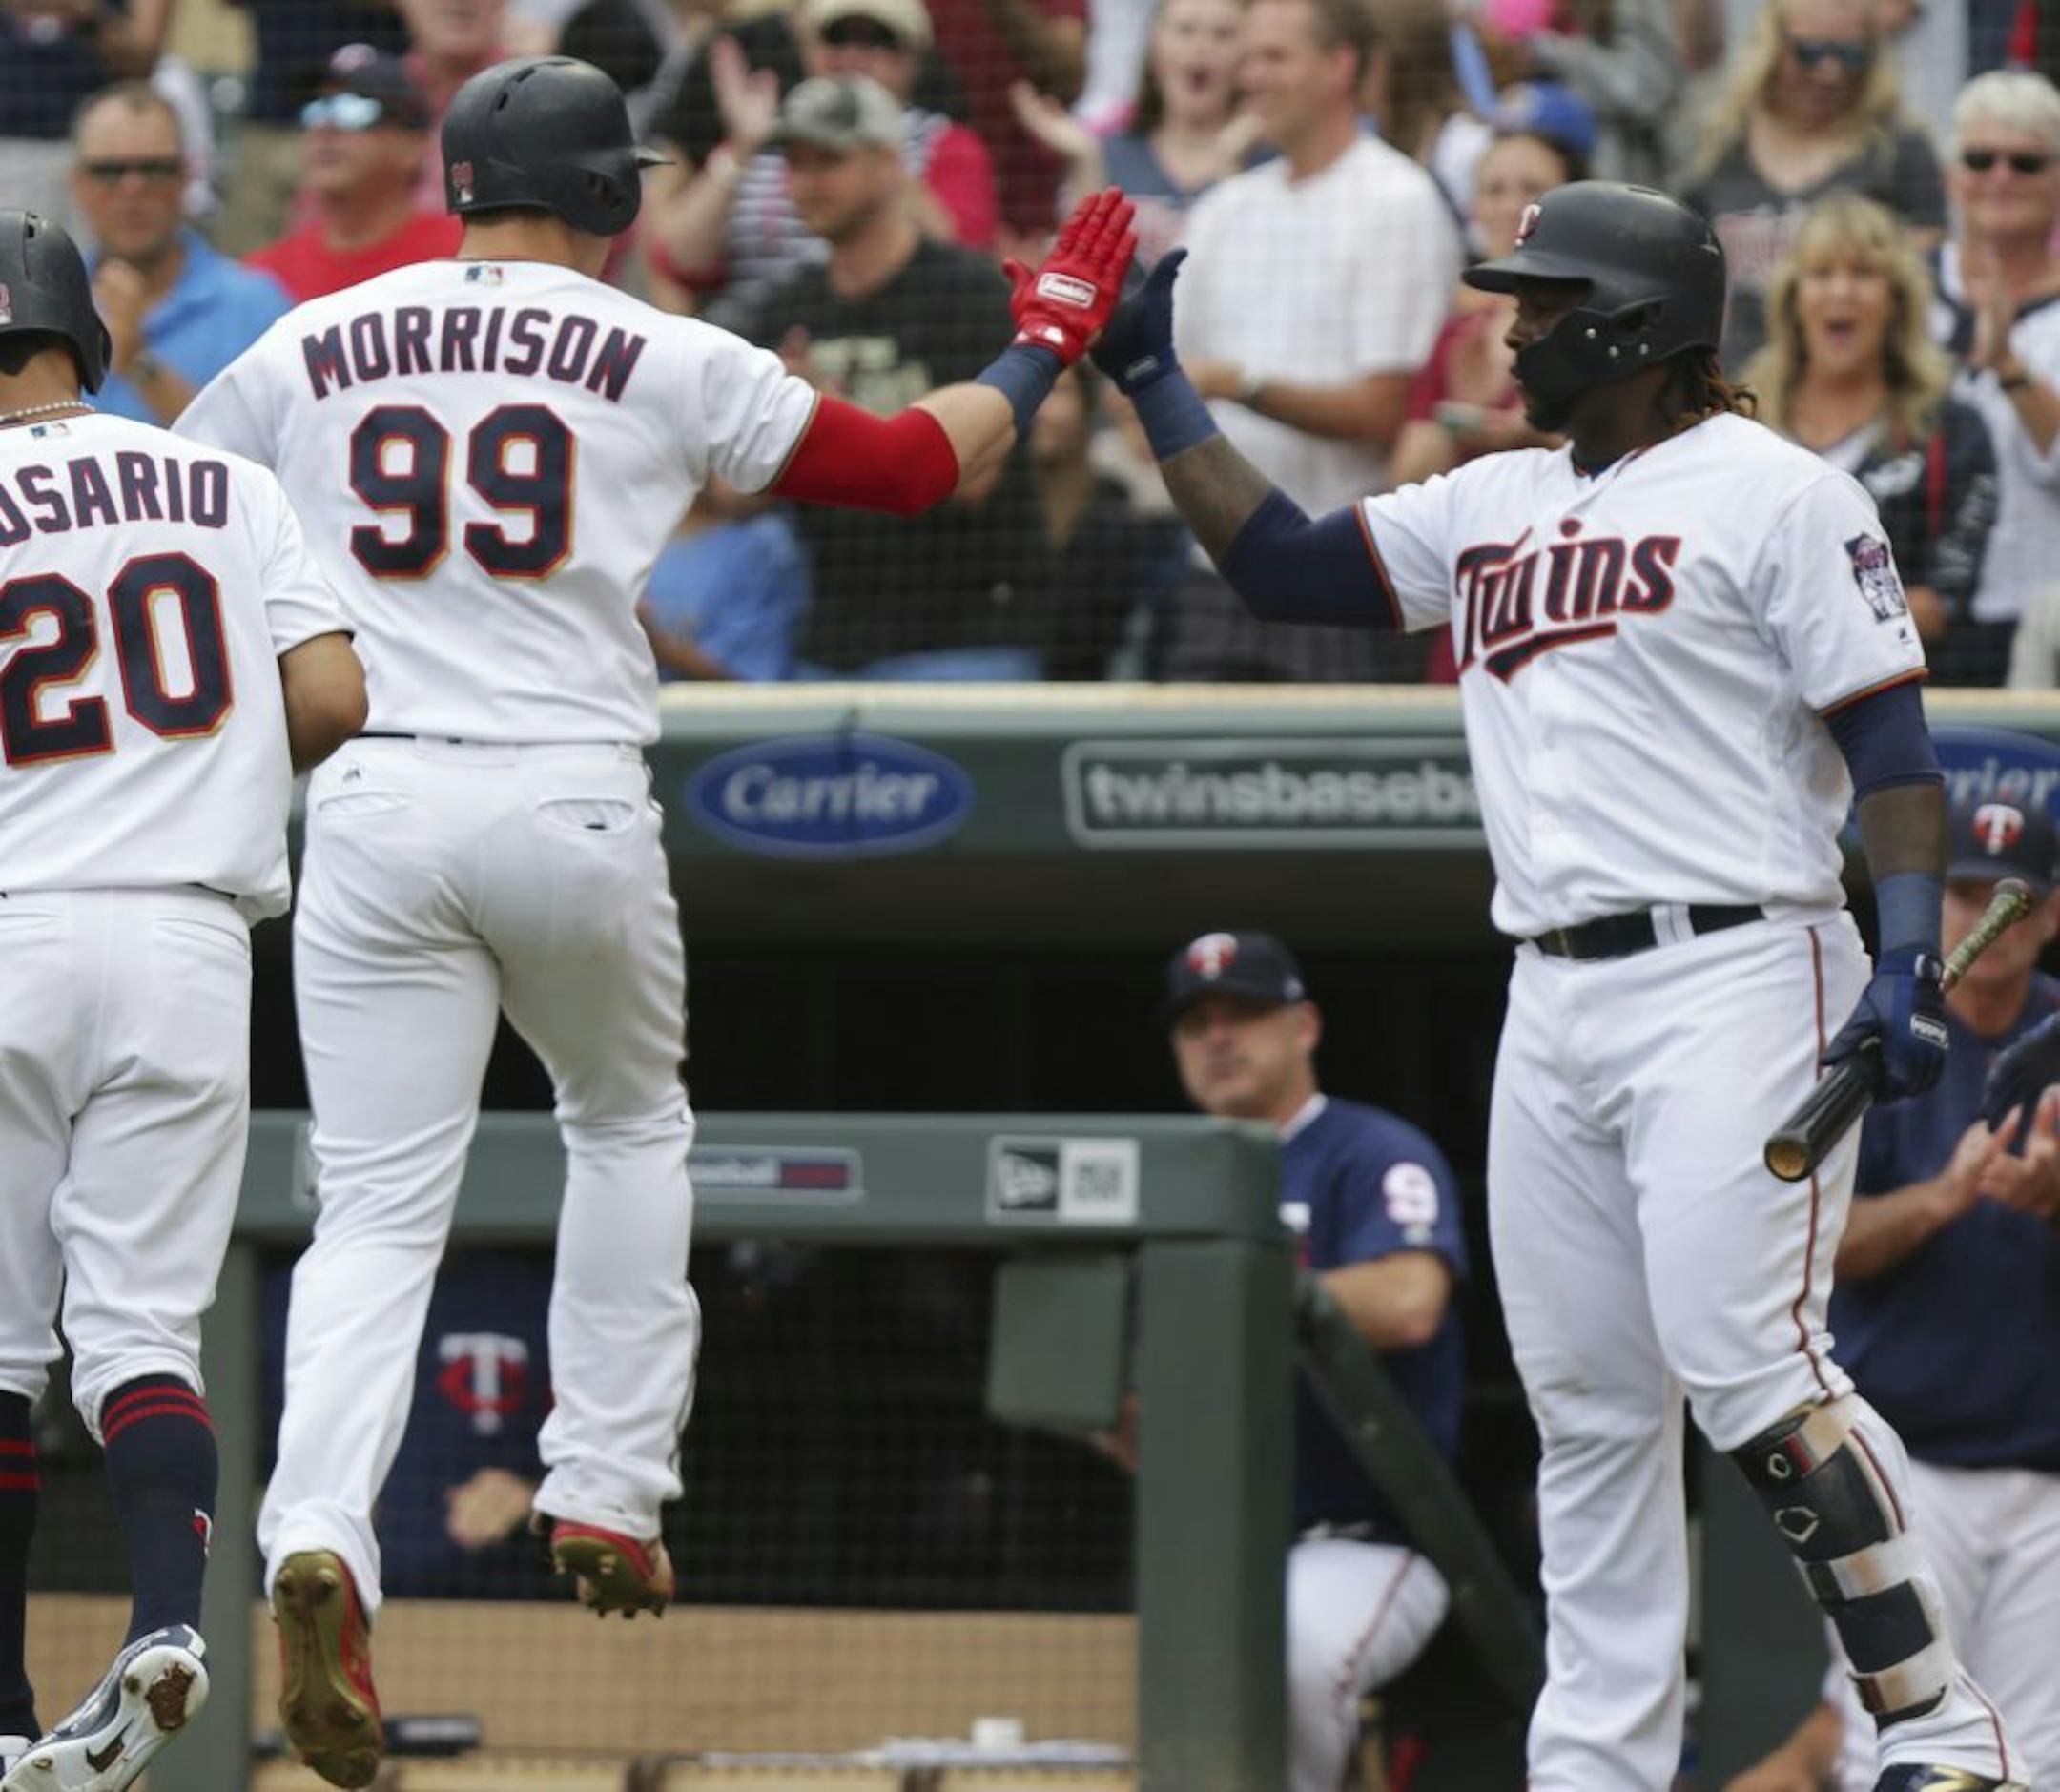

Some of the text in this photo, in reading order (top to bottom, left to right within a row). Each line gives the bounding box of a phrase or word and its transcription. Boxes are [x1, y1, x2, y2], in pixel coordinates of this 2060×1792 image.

[301, 306, 648, 403] MORRISON
[349, 403, 576, 582] 99
[0, 551, 233, 770] 20
[1455, 517, 1681, 674] Twins
[722, 763, 940, 822] Carrier
